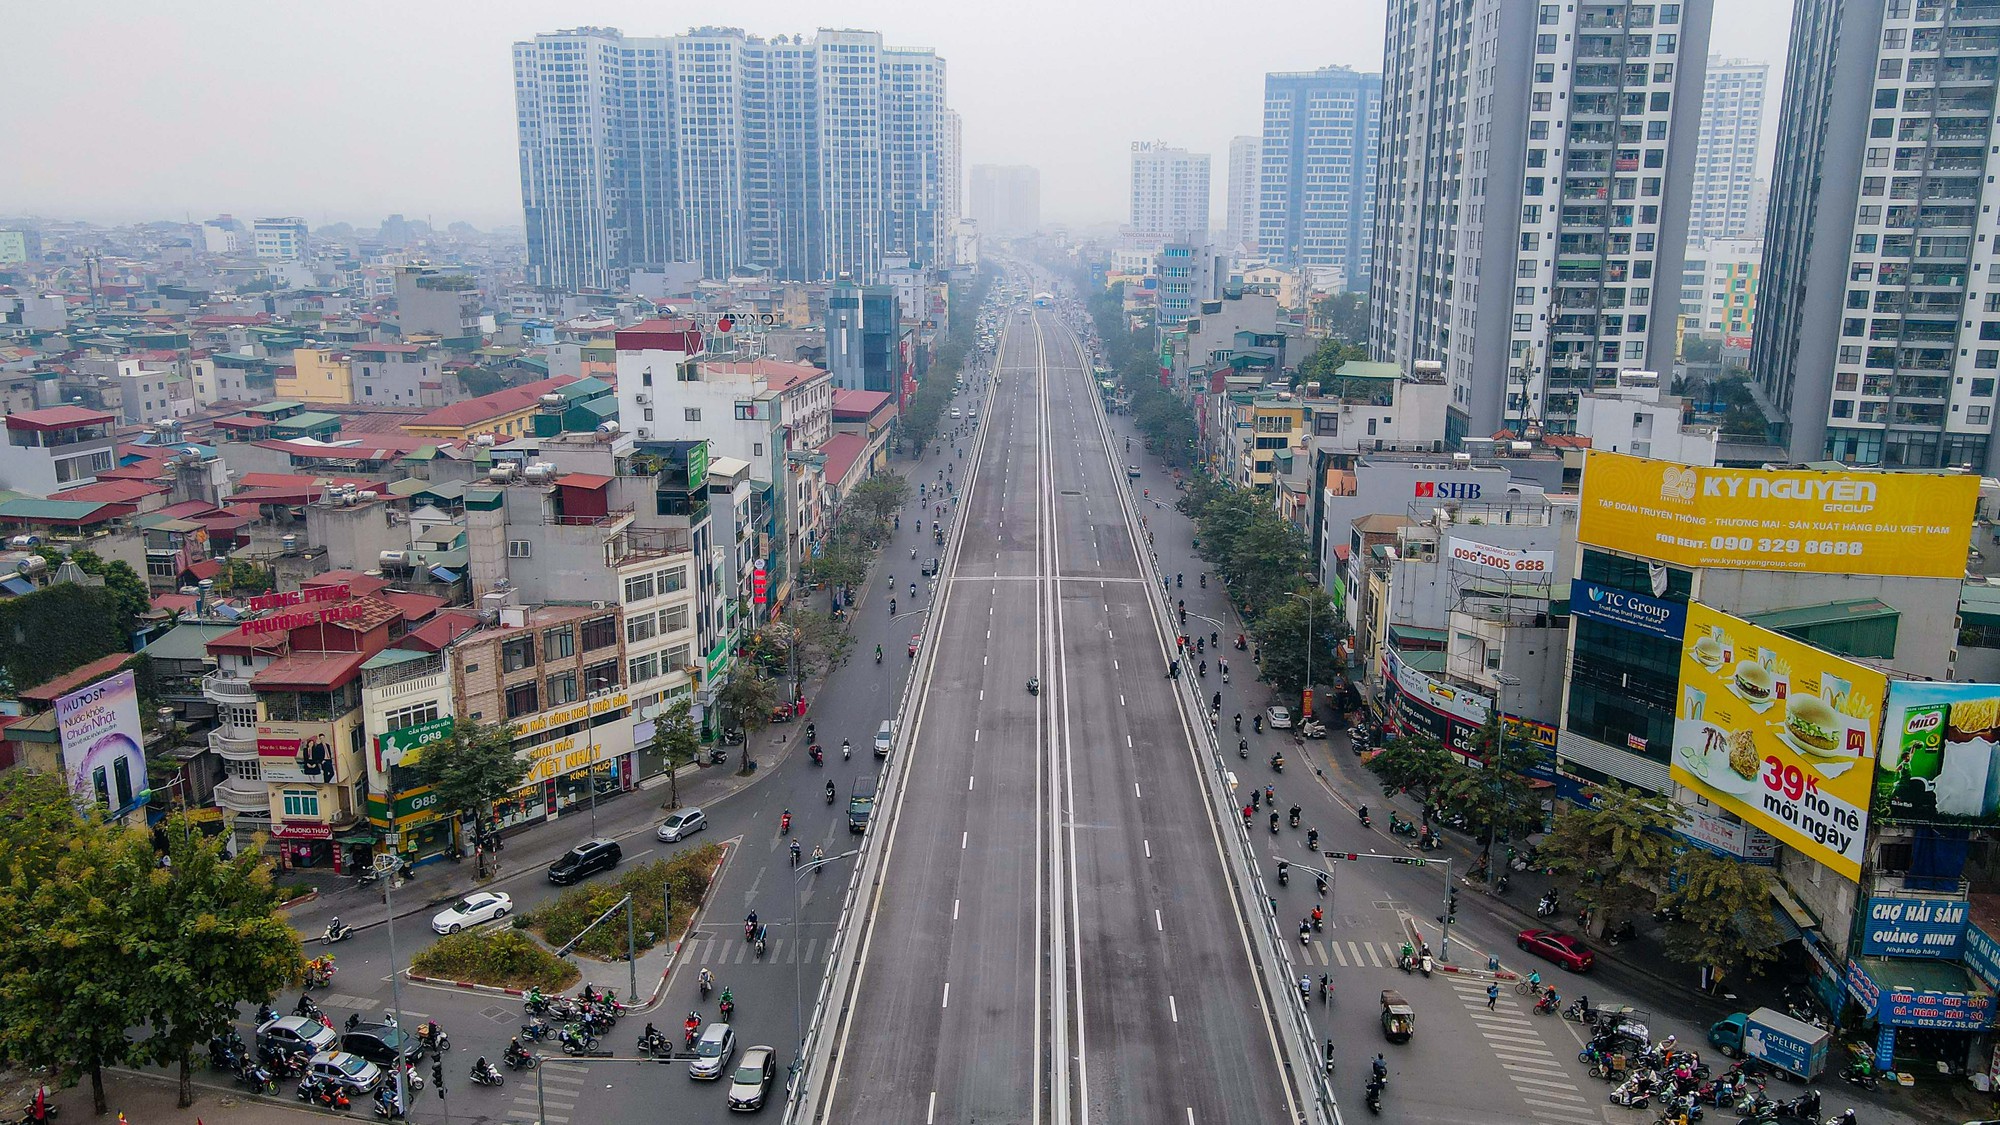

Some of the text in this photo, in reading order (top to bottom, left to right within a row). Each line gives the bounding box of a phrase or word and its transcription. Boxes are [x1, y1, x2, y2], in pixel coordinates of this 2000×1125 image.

[1437, 482, 1481, 499] SHB
[1823, 504, 1874, 513] GROUP
[1675, 513, 1706, 525] THÔNG
[1716, 518, 1759, 527] THƯƠNG
[1762, 520, 1780, 530] MẠI
[1926, 526, 1950, 534] NAM
[1656, 533, 1675, 544] FOR
[1710, 536, 1753, 550] 090
[1758, 538, 1800, 553] 329
[1805, 540, 1863, 556] 8688
[1454, 548, 1545, 571] 096 5005 688
[1700, 556, 1806, 568] www.kynguyengroup.com
[1605, 591, 1624, 607] TC
[1627, 597, 1670, 621] Group
[1909, 717, 1939, 730] MILO
[419, 731, 442, 744] F88
[411, 794, 437, 810] F88
[1804, 792, 1859, 832] no nê
[1763, 793, 1799, 825] mỗi
[1802, 814, 1852, 855] ngày
[1872, 900, 1963, 925] CHỢ HẢI SẢN
[1872, 927, 1956, 946] QUẢNG NINH
[1905, 947, 1921, 955] ship
[1922, 948, 1940, 957] hàng
[1891, 993, 1911, 1003] TÔM
[1917, 996, 1936, 1004] CUA
[1894, 1006, 1907, 1015] CÁ
[1913, 1008, 1938, 1017] NGAO
[1766, 1033, 1805, 1054] SPELIER
